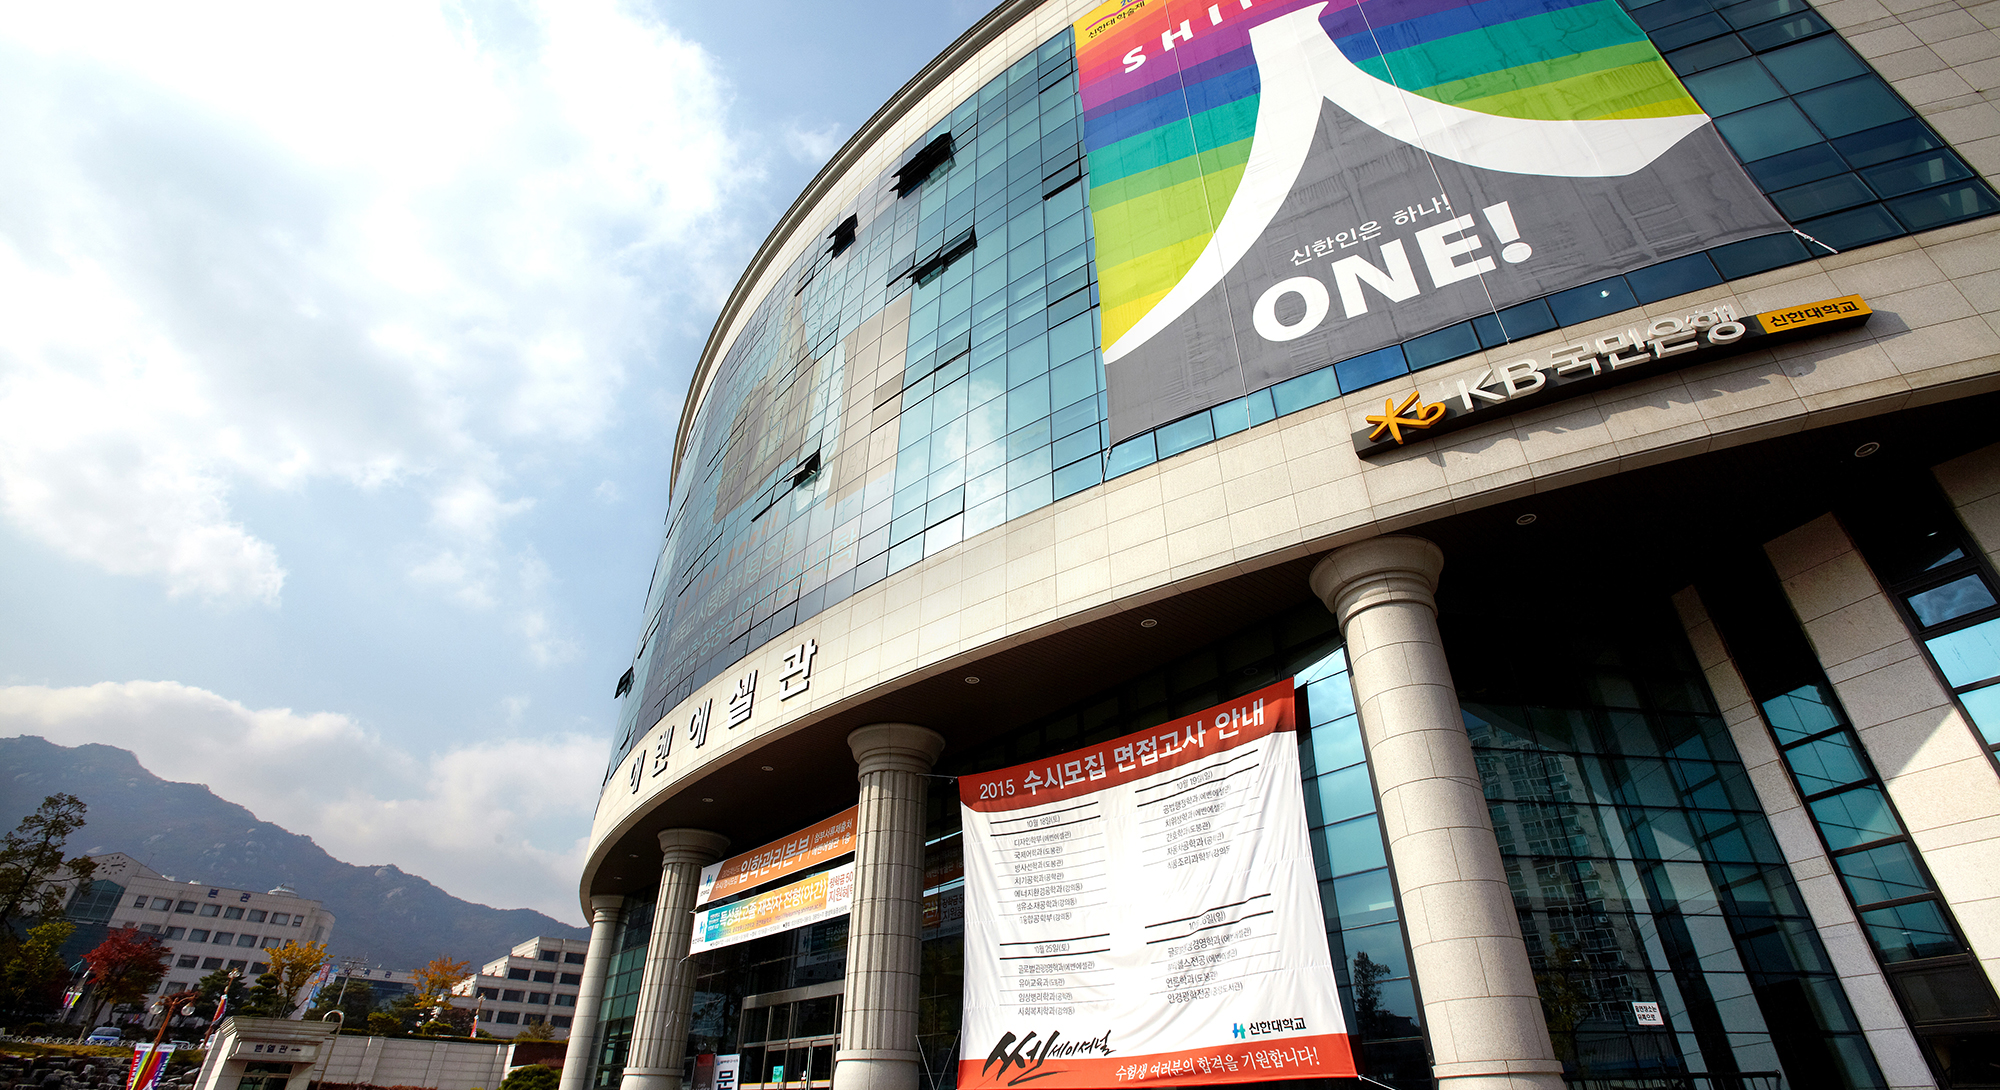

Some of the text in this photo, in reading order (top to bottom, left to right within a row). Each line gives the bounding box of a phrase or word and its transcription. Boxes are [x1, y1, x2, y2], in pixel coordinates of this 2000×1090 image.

[1088, 1, 1146, 39] 신한대 학술제
[1122, 0, 1253, 73] SHI
[1290, 192, 1451, 266] 신한인은 하나!
[1252, 200, 1533, 342] ONE!
[1770, 300, 1860, 328] 신한대학교
[630, 638, 818, 795] 에벤에셀관
[979, 697, 1265, 800] 2015 수시모집 면접고사 안내
[738, 835, 810, 884] 입학관리본부
[1249, 1016, 1306, 1035] 신한대학교
[1115, 1046, 1321, 1082] 수험생 여러분의 합격을 기원합니다!
